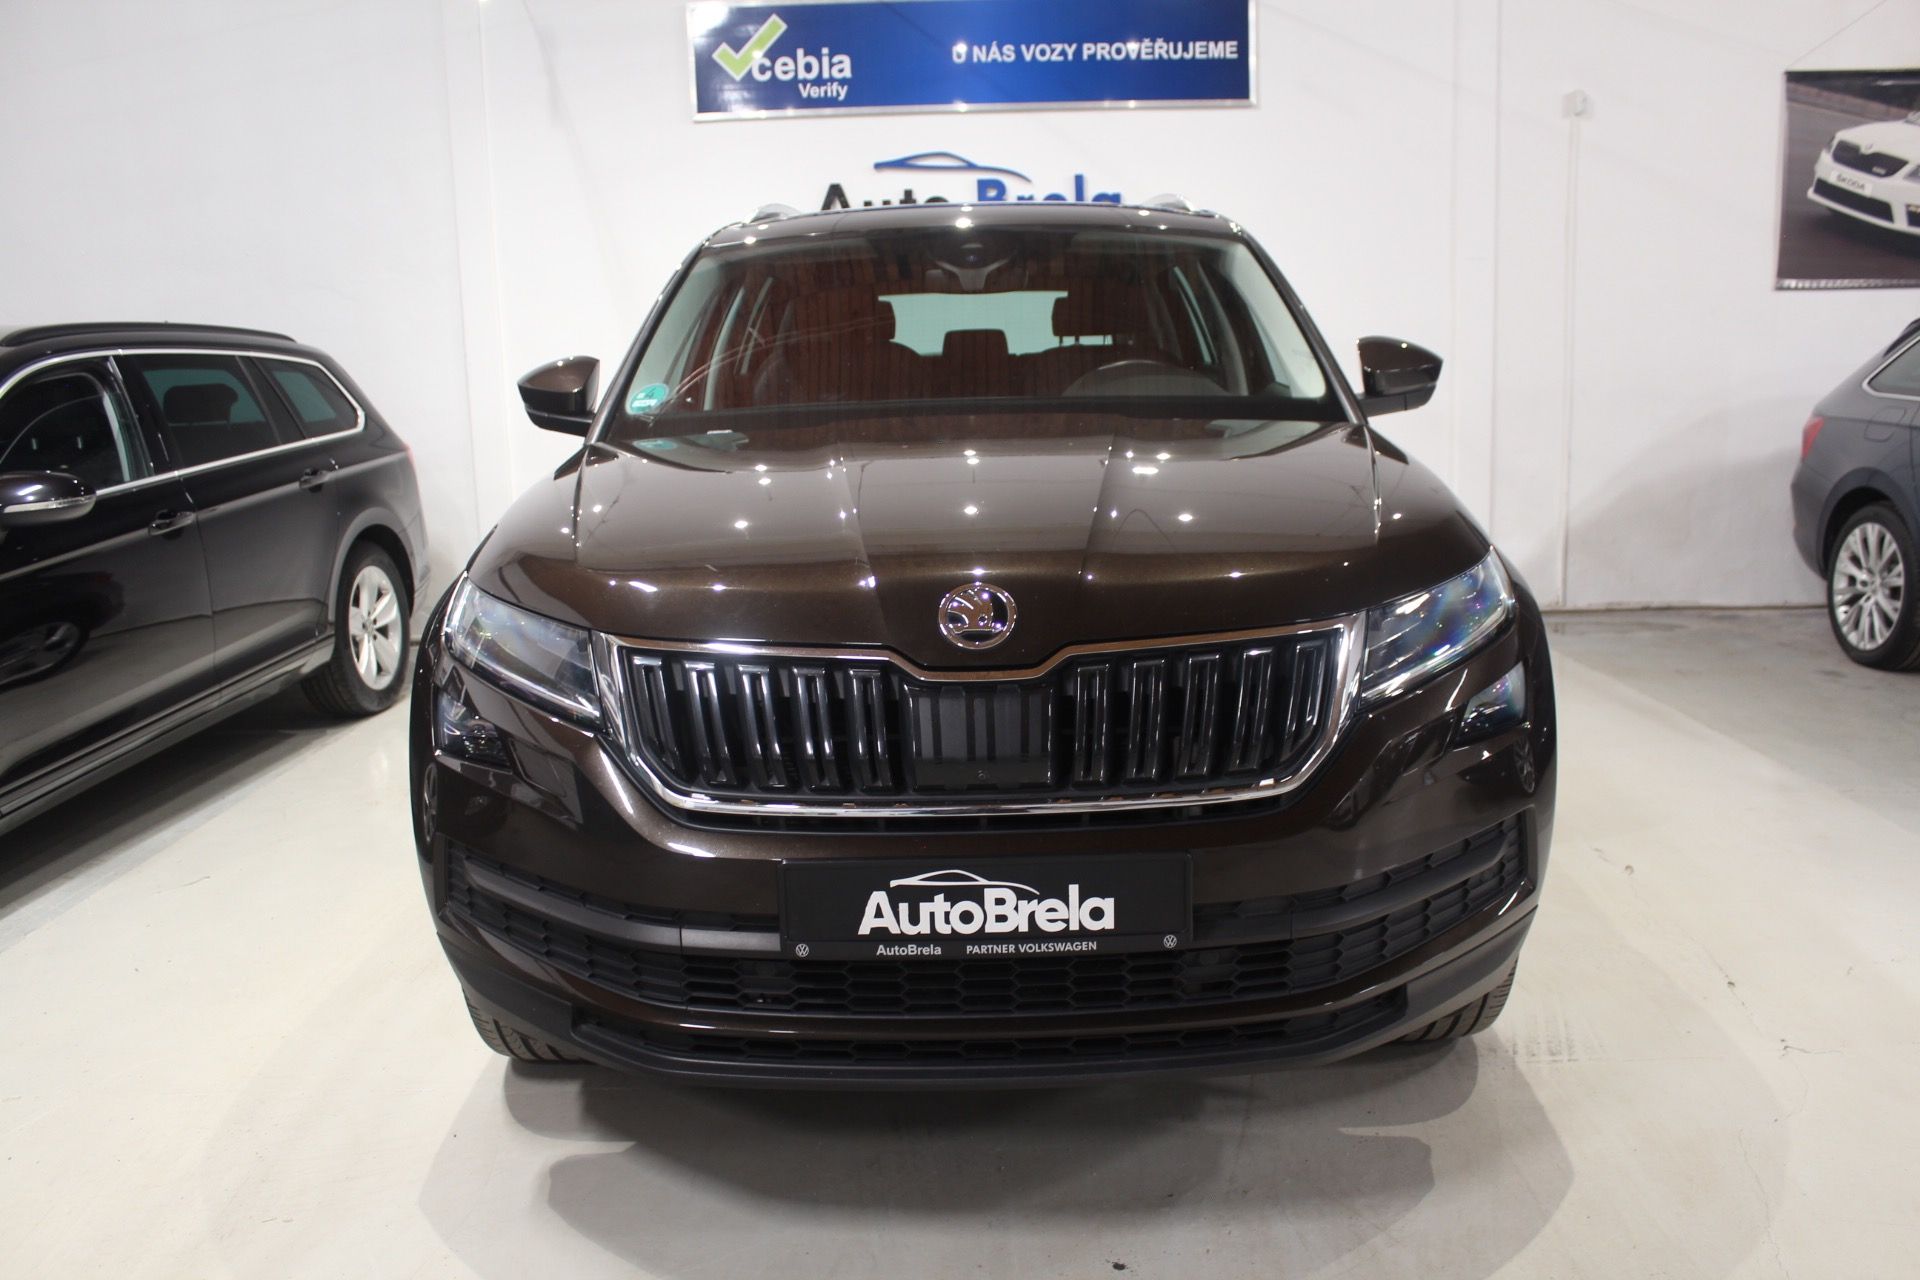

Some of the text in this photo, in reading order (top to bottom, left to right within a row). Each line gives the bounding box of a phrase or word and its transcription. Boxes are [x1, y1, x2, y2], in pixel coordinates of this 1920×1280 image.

[972, 41, 1016, 63] NÁS
[1021, 42, 1078, 62] VOZY
[1082, 38, 1239, 61] PROVĚŘUJEME
[751, 47, 852, 82] cebia
[798, 81, 848, 102] Verify
[858, 883, 1115, 936] AutoBrela
[876, 943, 942, 956] AutoBrela
[966, 941, 1098, 955] PARTNER VOLKSWAGEN
